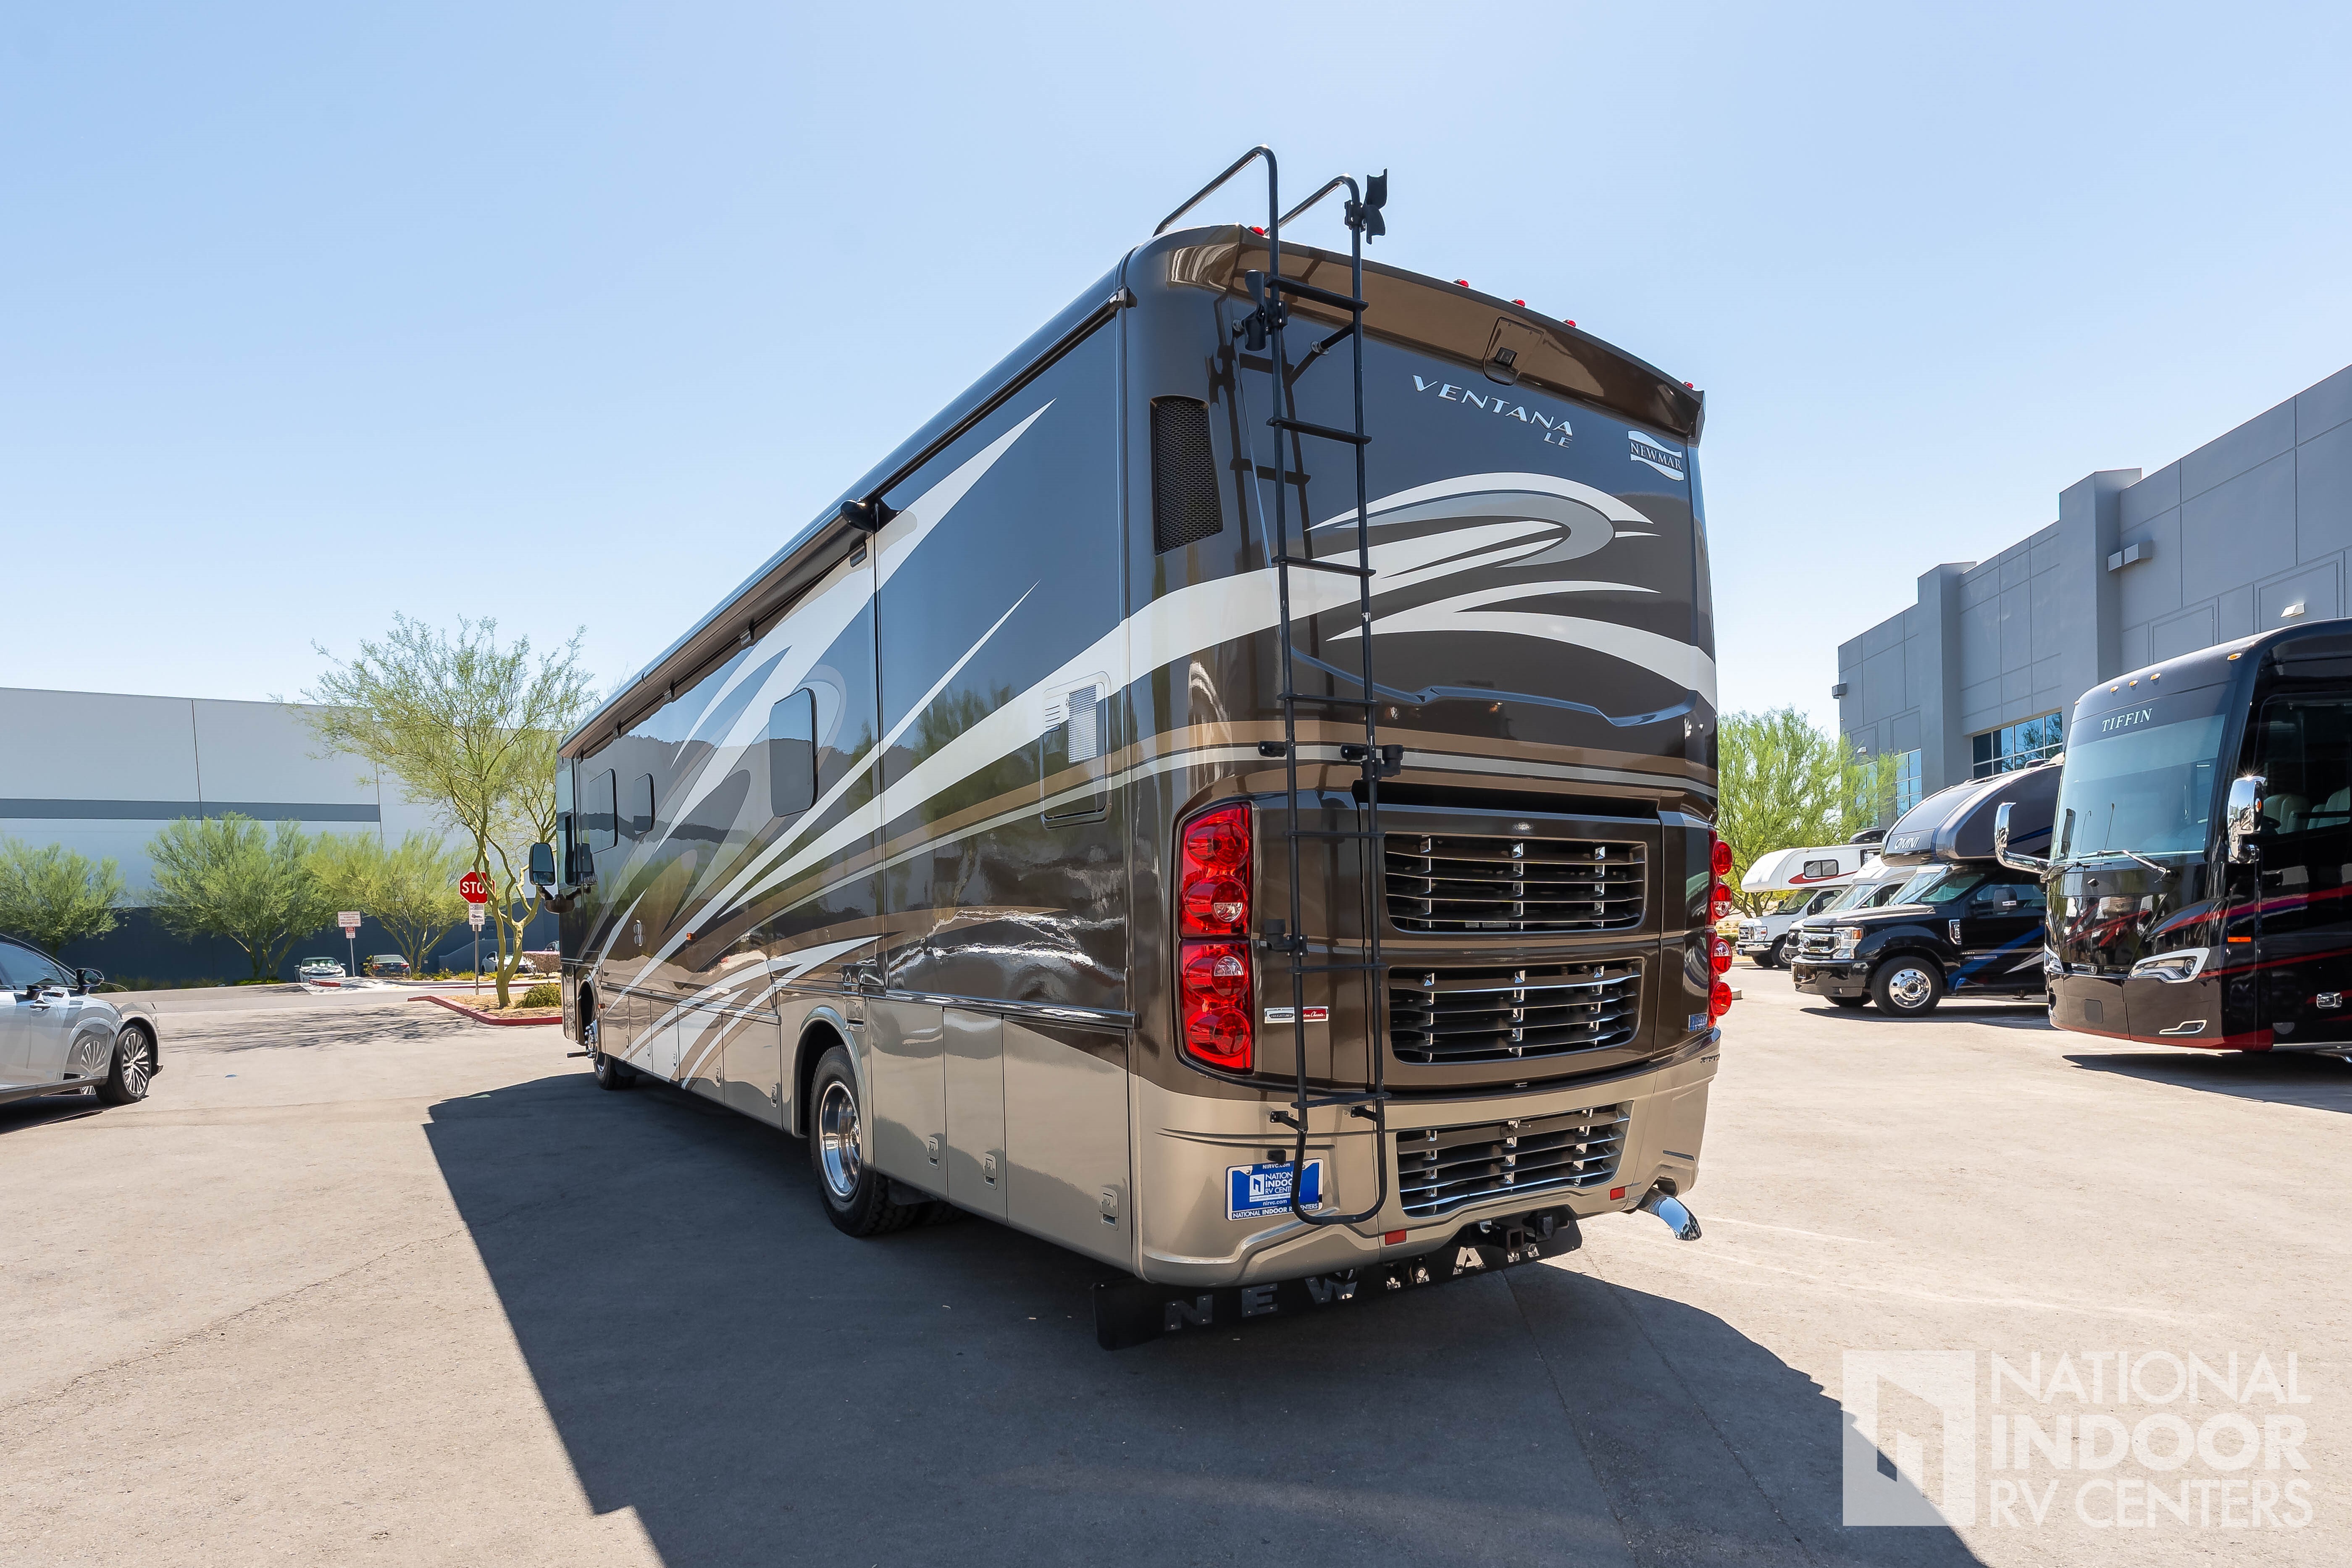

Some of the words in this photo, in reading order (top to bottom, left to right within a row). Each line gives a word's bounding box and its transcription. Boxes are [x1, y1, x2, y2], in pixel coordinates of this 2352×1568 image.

[1412, 375, 1573, 436] VENTANA
[1543, 432, 1573, 448] LE
[1630, 442, 1682, 470] NEWMAR
[2102, 708, 2152, 732] TIFFIN
[1895, 837, 1921, 850] OMNI
[462, 881, 488, 894] STO
[1265, 1171, 1293, 1180] NATION
[1265, 1178, 1293, 1188] INDOO
[1262, 1207, 1287, 1215] INDOOR
